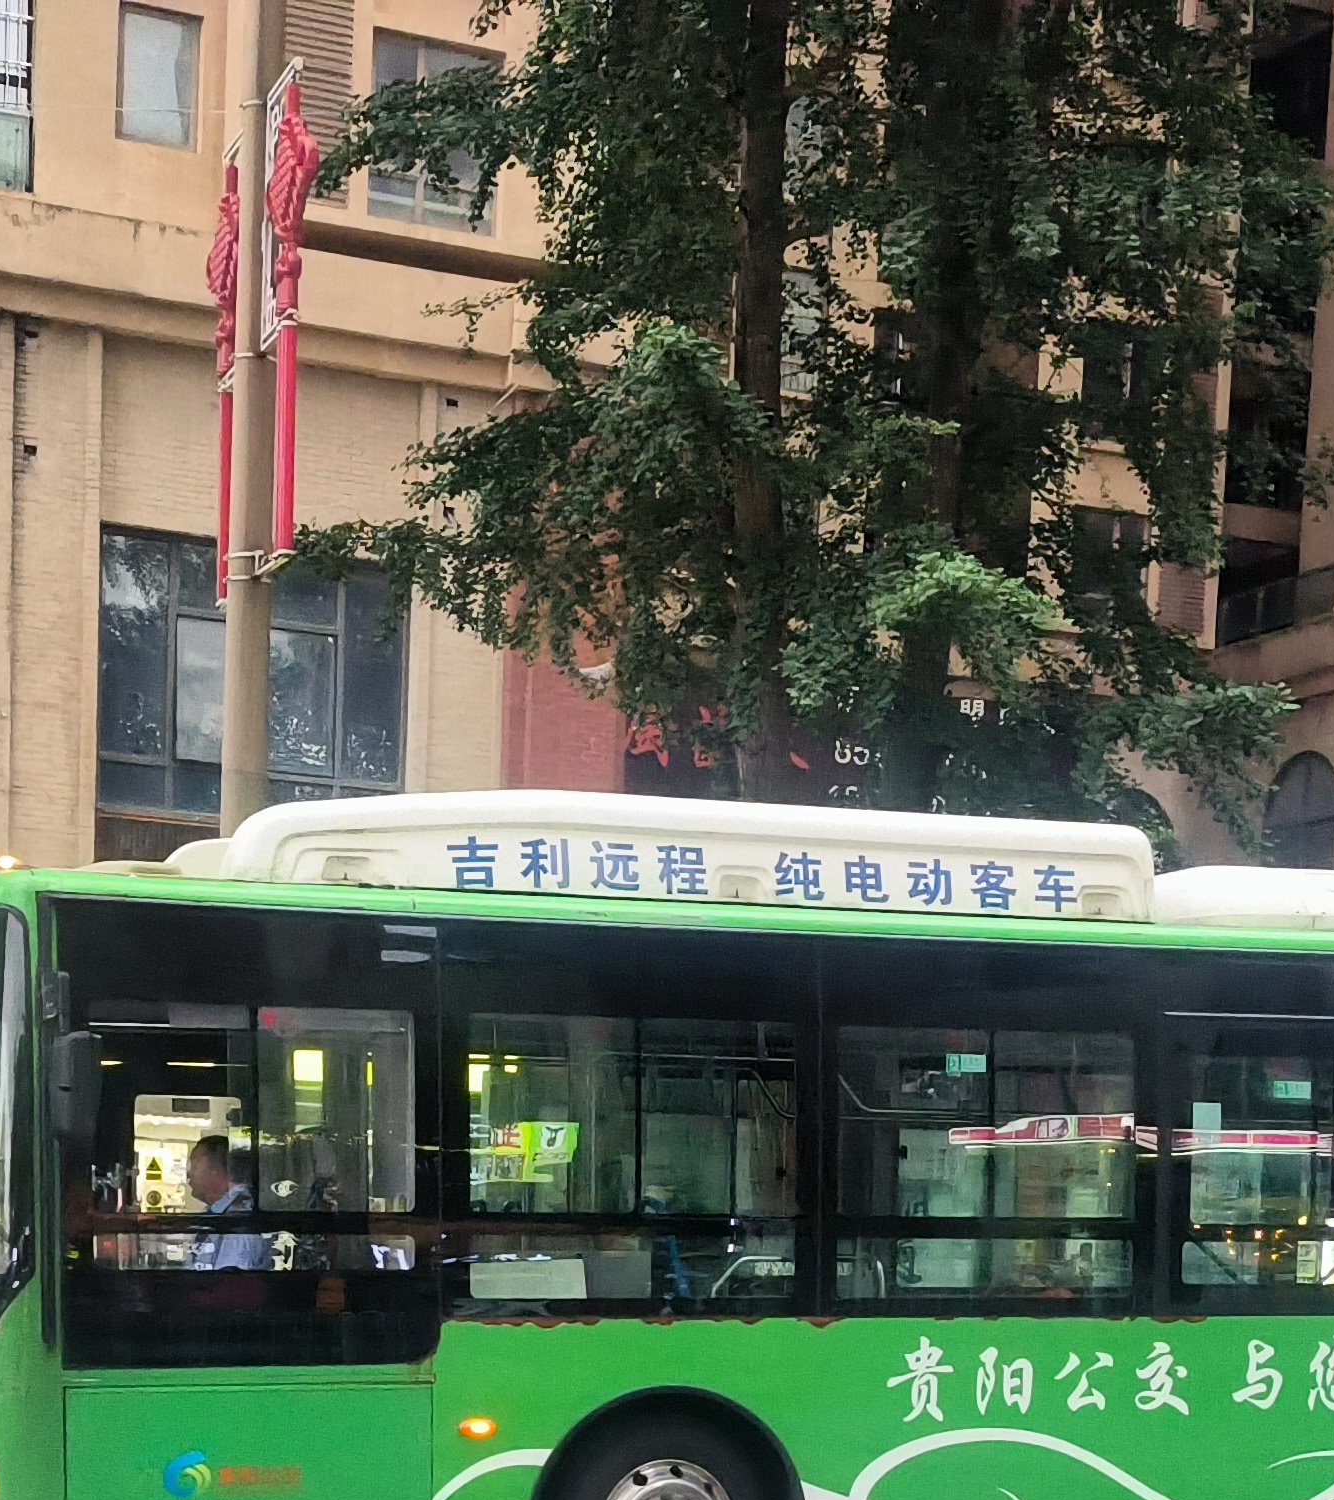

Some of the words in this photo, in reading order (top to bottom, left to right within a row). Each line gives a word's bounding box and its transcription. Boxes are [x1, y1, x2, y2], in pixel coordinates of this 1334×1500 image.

[447, 836, 708, 894] 吉利远程
[774, 851, 1079, 912] 纯电动客车
[887, 1335, 1190, 1422] 贵阳公交
